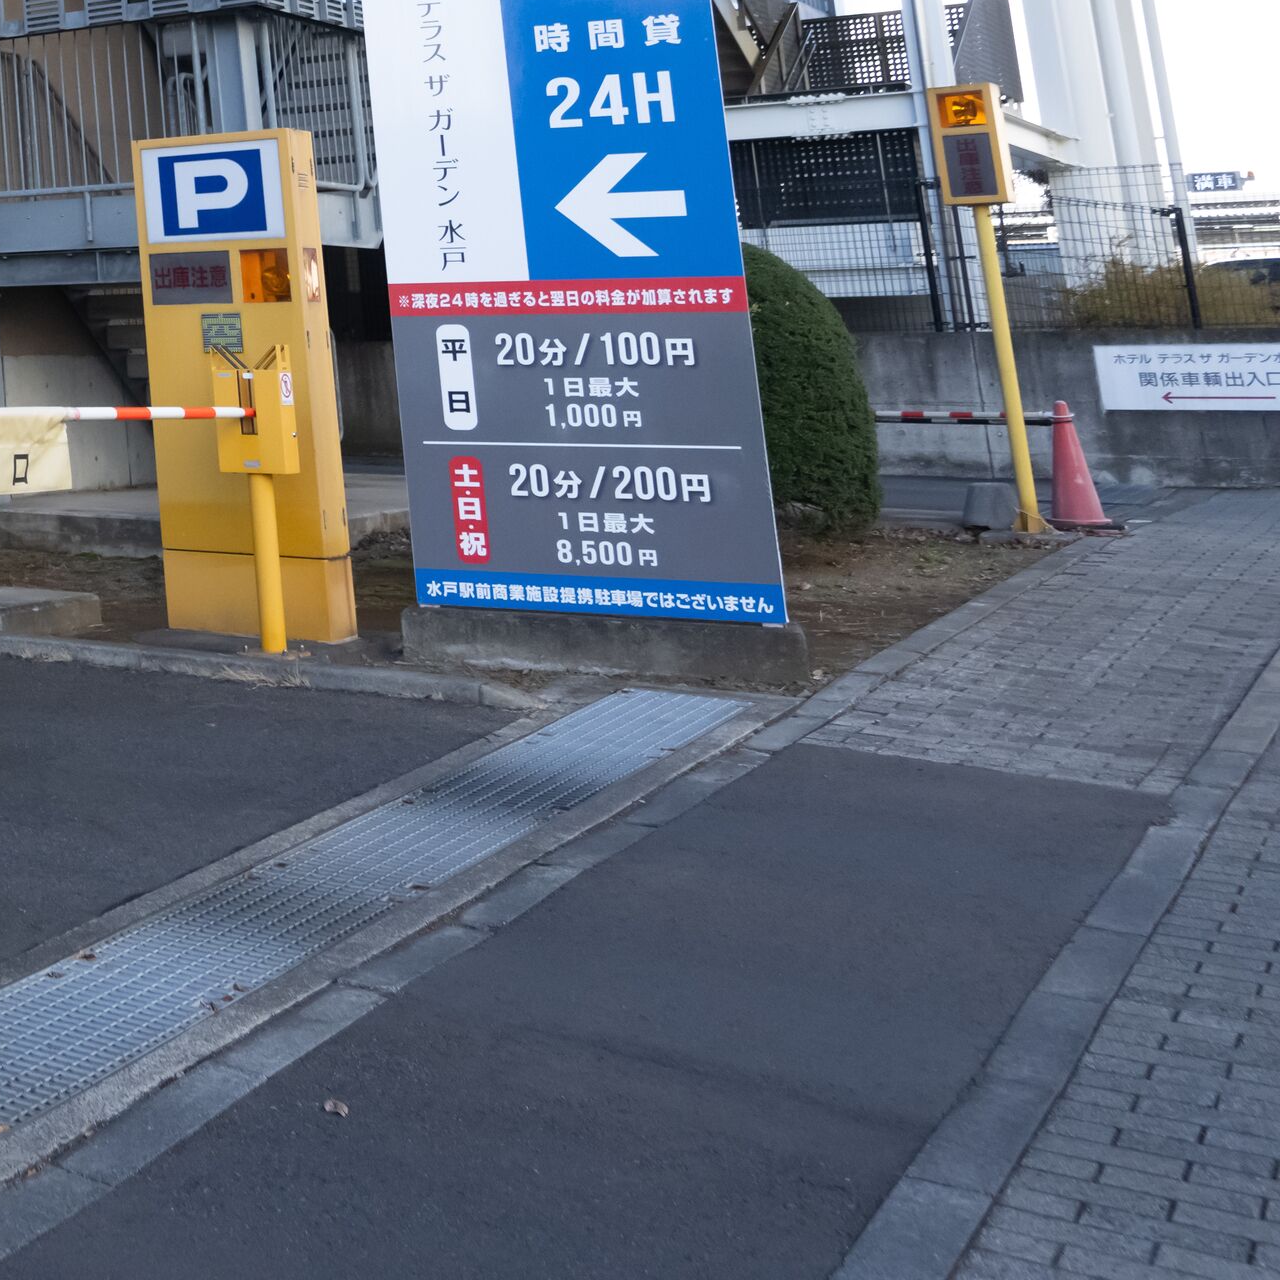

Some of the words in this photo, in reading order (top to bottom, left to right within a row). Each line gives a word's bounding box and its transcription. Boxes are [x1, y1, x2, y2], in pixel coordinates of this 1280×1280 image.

[533, 14, 682, 53] 時間貸
[424, 73, 450, 97] ザ
[545, 70, 676, 128] 24H
[429, 107, 460, 208] ガーデン
[173, 158, 249, 229] P
[1194, 173, 1236, 190] 満車
[437, 219, 466, 271] 水戸
[154, 265, 228, 290] 出庫注意
[398, 288, 733, 309] ※深夜24時を過ぎると翌日の料金が加算されます
[1113, 353, 1152, 365] ホテル
[1157, 353, 1196, 364] テラス
[1199, 353, 1212, 364] ザ
[441, 338, 471, 414] 平日
[544, 377, 640, 398] 1日最大
[558, 512, 656, 535] 1日最大
[425, 580, 774, 615] 水戸駅前商業施設提携駐車場ではございません
